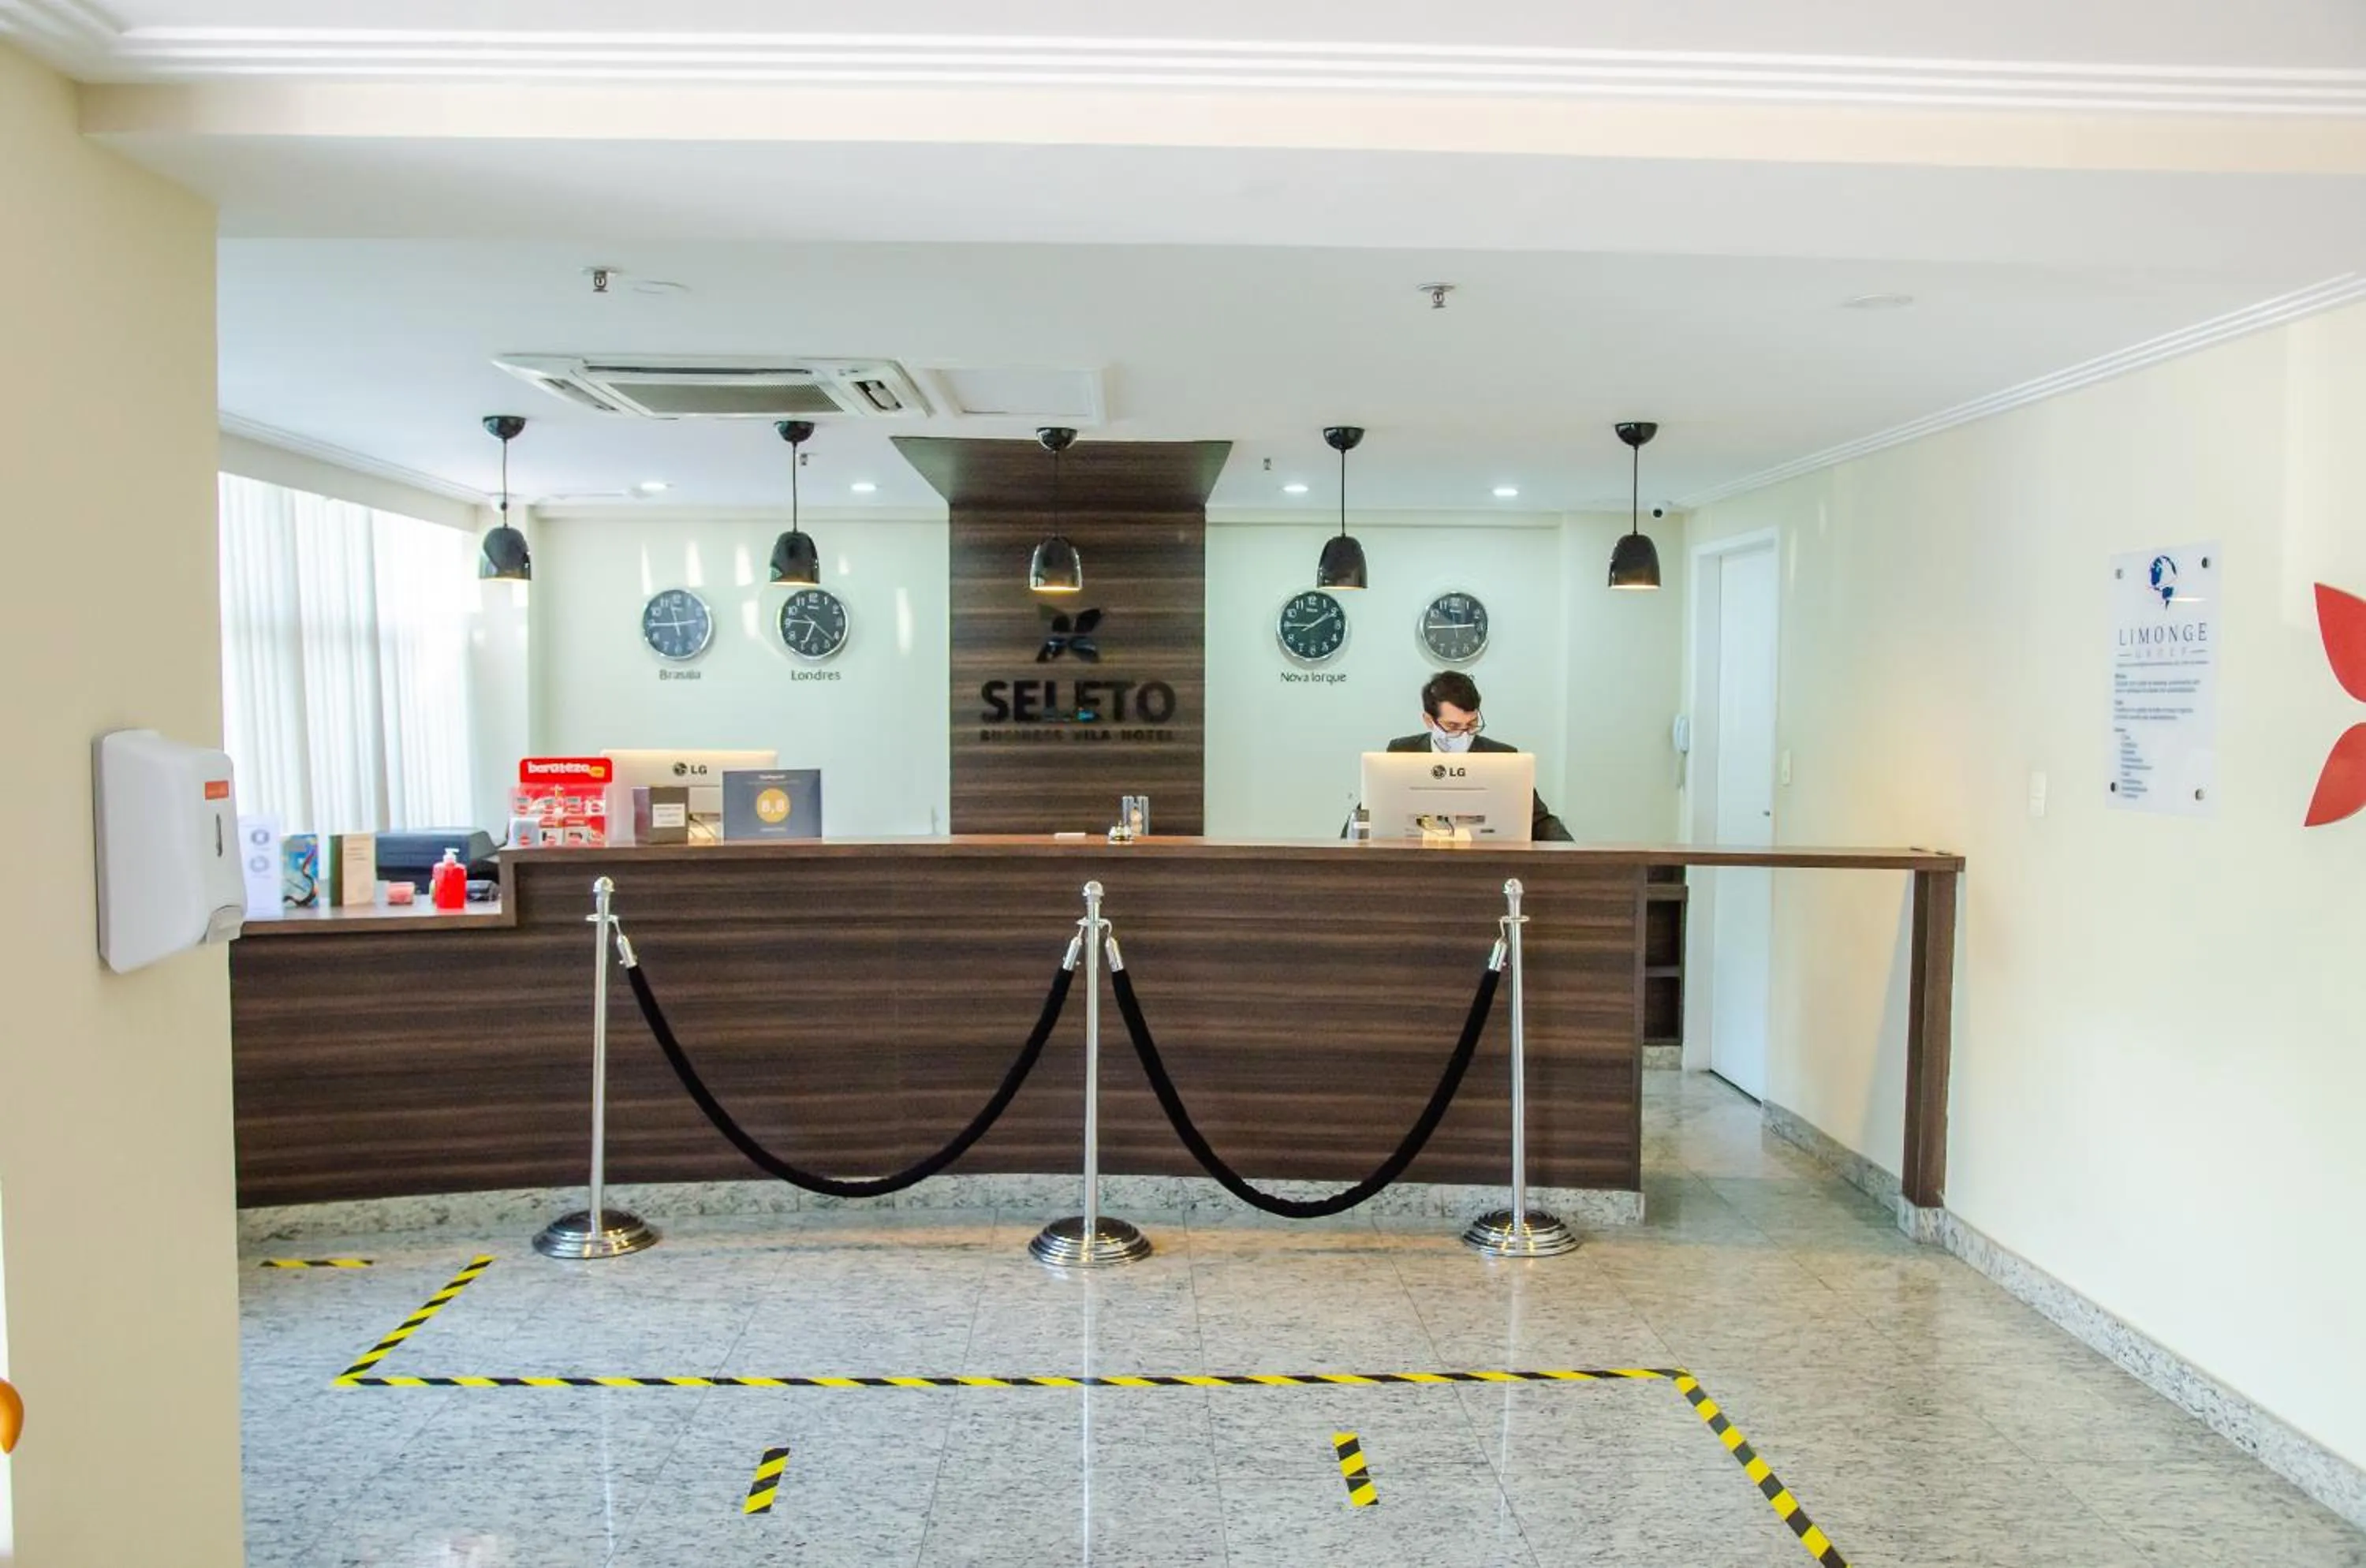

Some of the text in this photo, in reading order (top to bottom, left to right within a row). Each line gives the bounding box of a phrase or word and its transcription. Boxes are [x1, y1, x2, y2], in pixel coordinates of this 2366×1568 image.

[2119, 622, 2207, 645] LIMONGE
[791, 670, 841, 681] Londres
[1280, 672, 1309, 682] Nova
[981, 680, 1176, 723] SELETO
[691, 764, 707, 775] LG
[1449, 767, 1465, 777] LG
